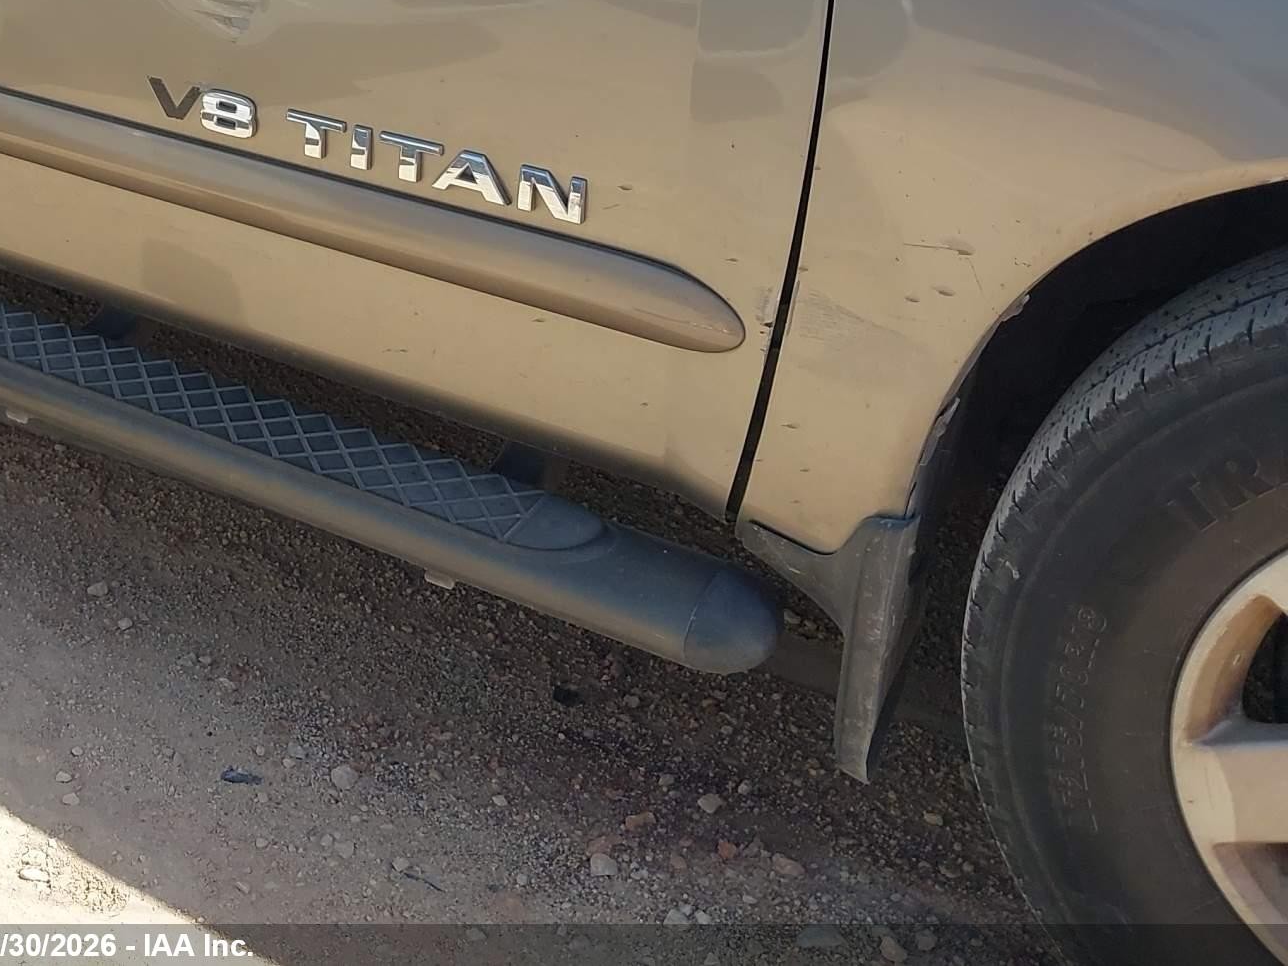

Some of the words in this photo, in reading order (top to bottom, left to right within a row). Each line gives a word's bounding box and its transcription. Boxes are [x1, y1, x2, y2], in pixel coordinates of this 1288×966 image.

[147, 75, 257, 139] V8
[286, 108, 587, 225] TITAN
[1166, 439, 1288, 531] TR
